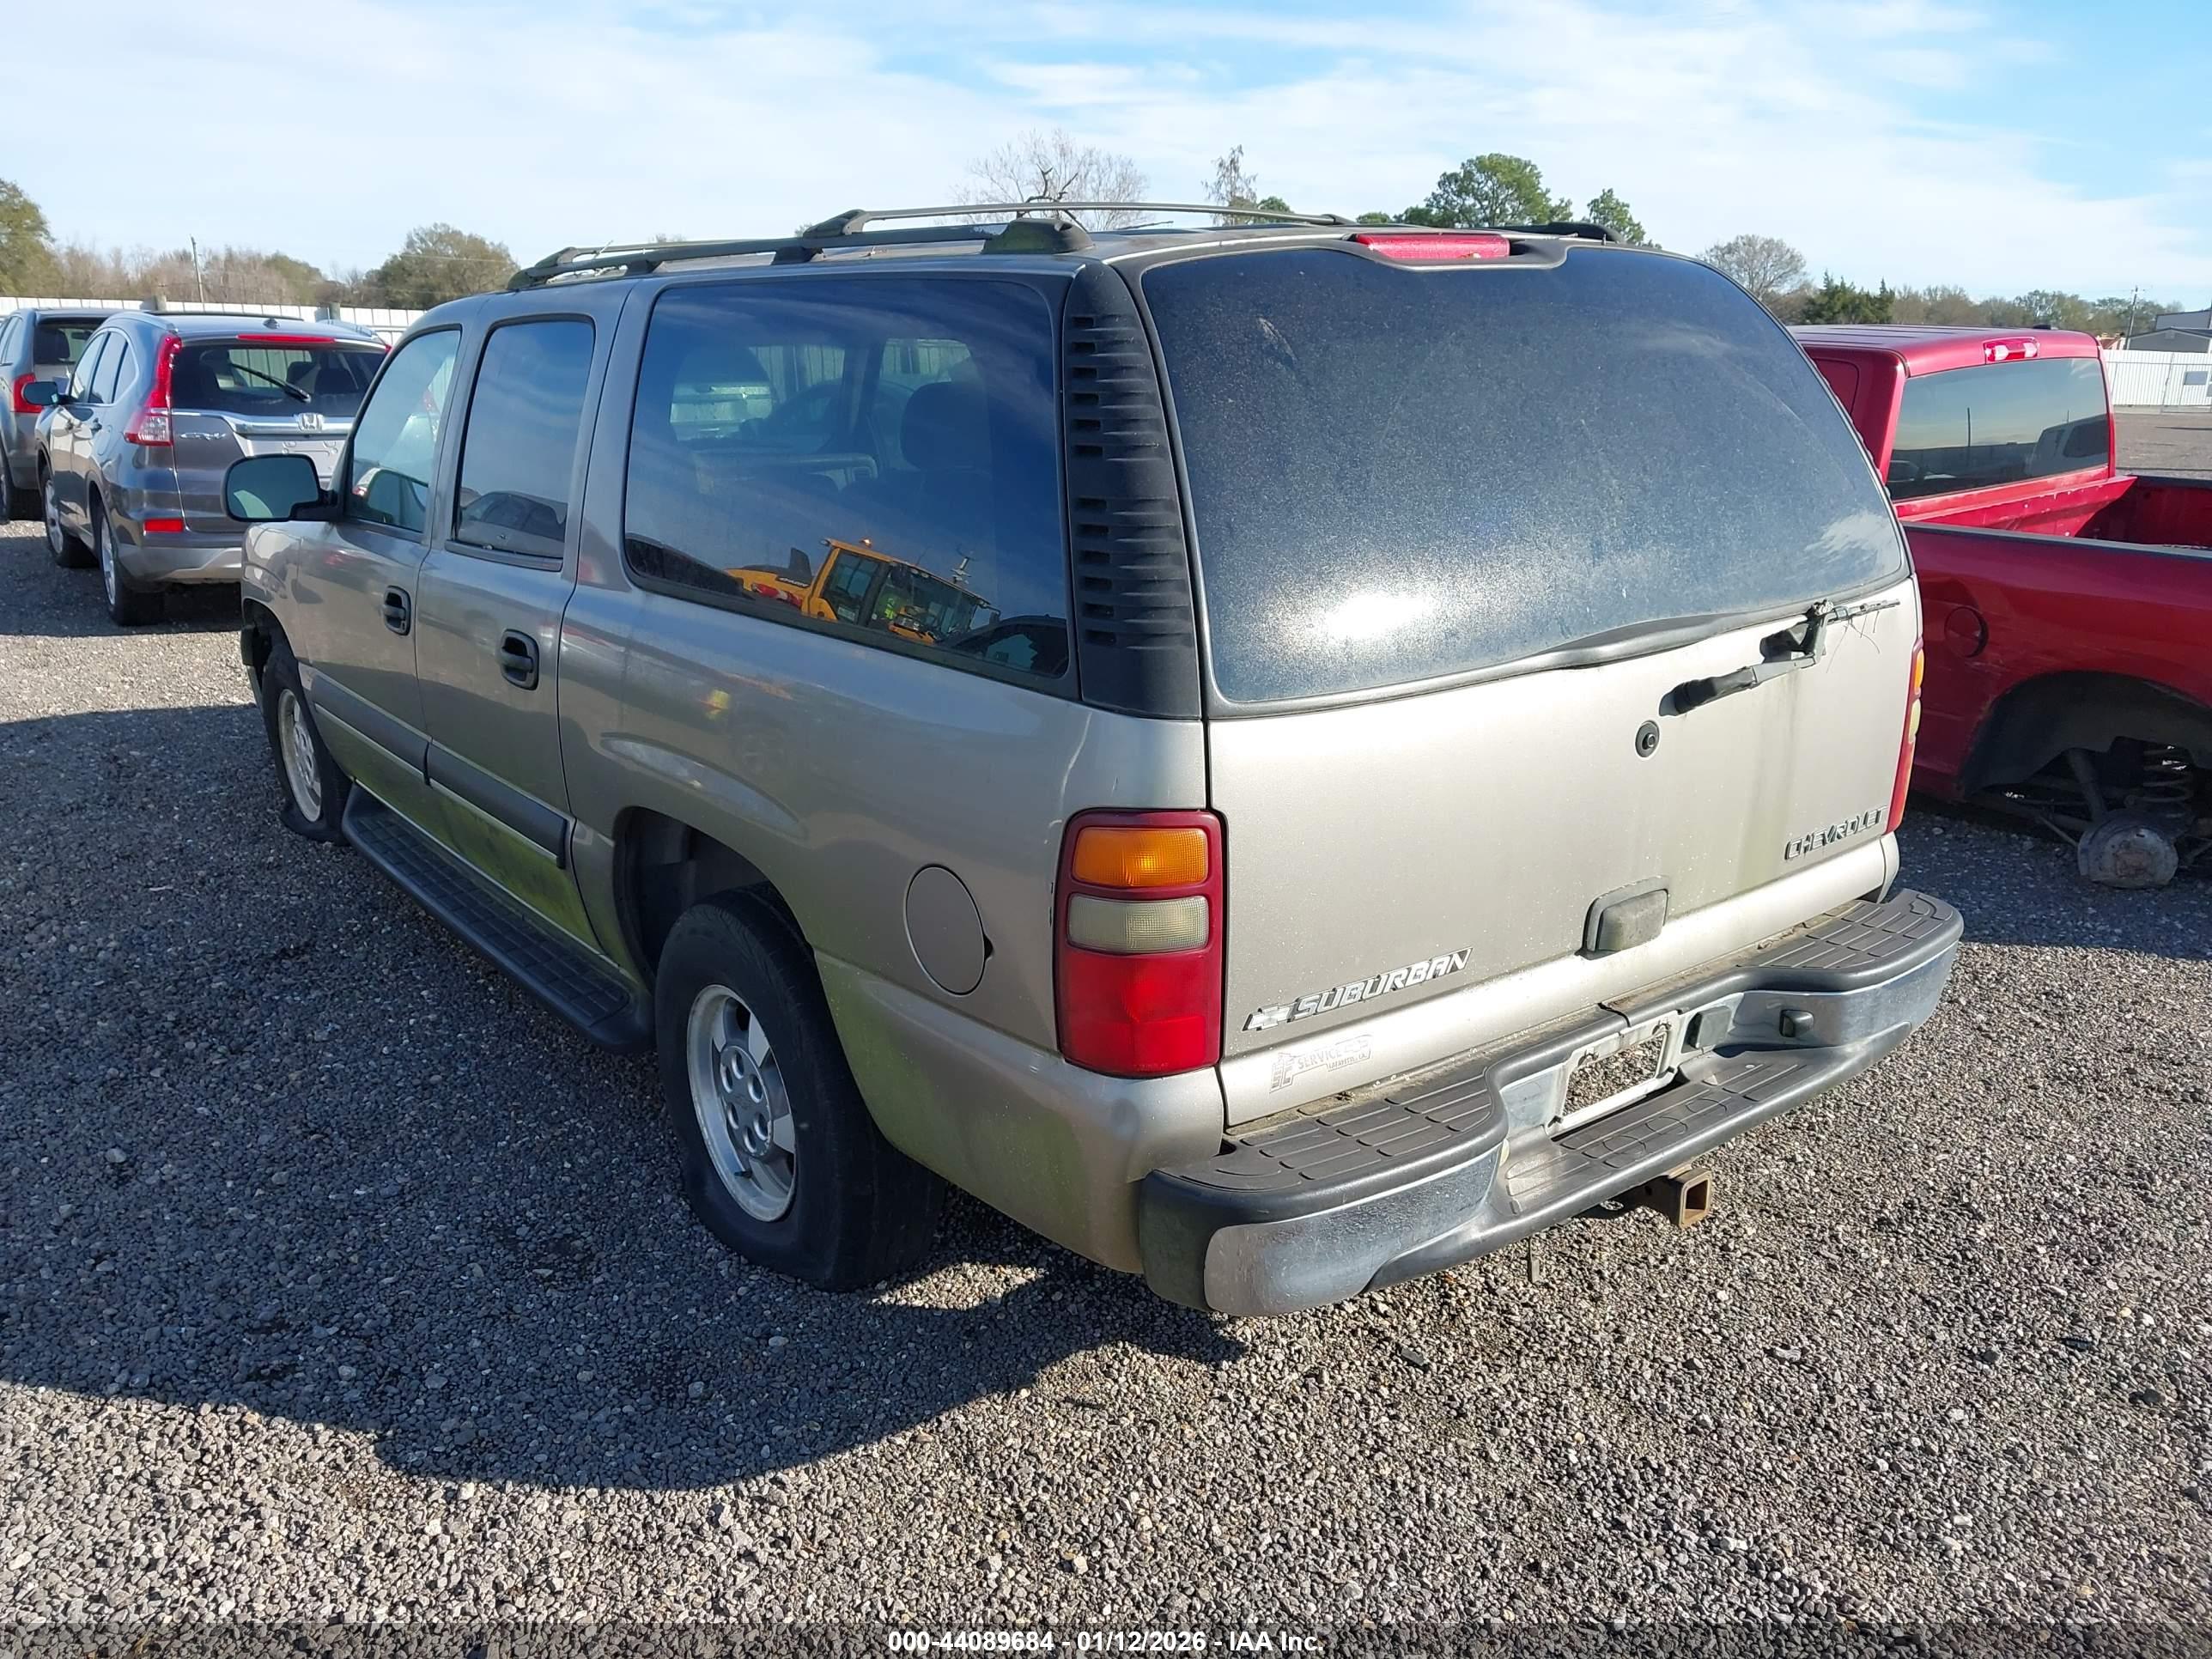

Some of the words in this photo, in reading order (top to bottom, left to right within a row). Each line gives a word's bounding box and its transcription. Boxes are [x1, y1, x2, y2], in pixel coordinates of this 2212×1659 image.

[1784, 805, 1887, 860] CHEVROLET
[1292, 947, 1473, 1022] SUBURBAN
[1297, 1048, 1341, 1070] SERVICE
